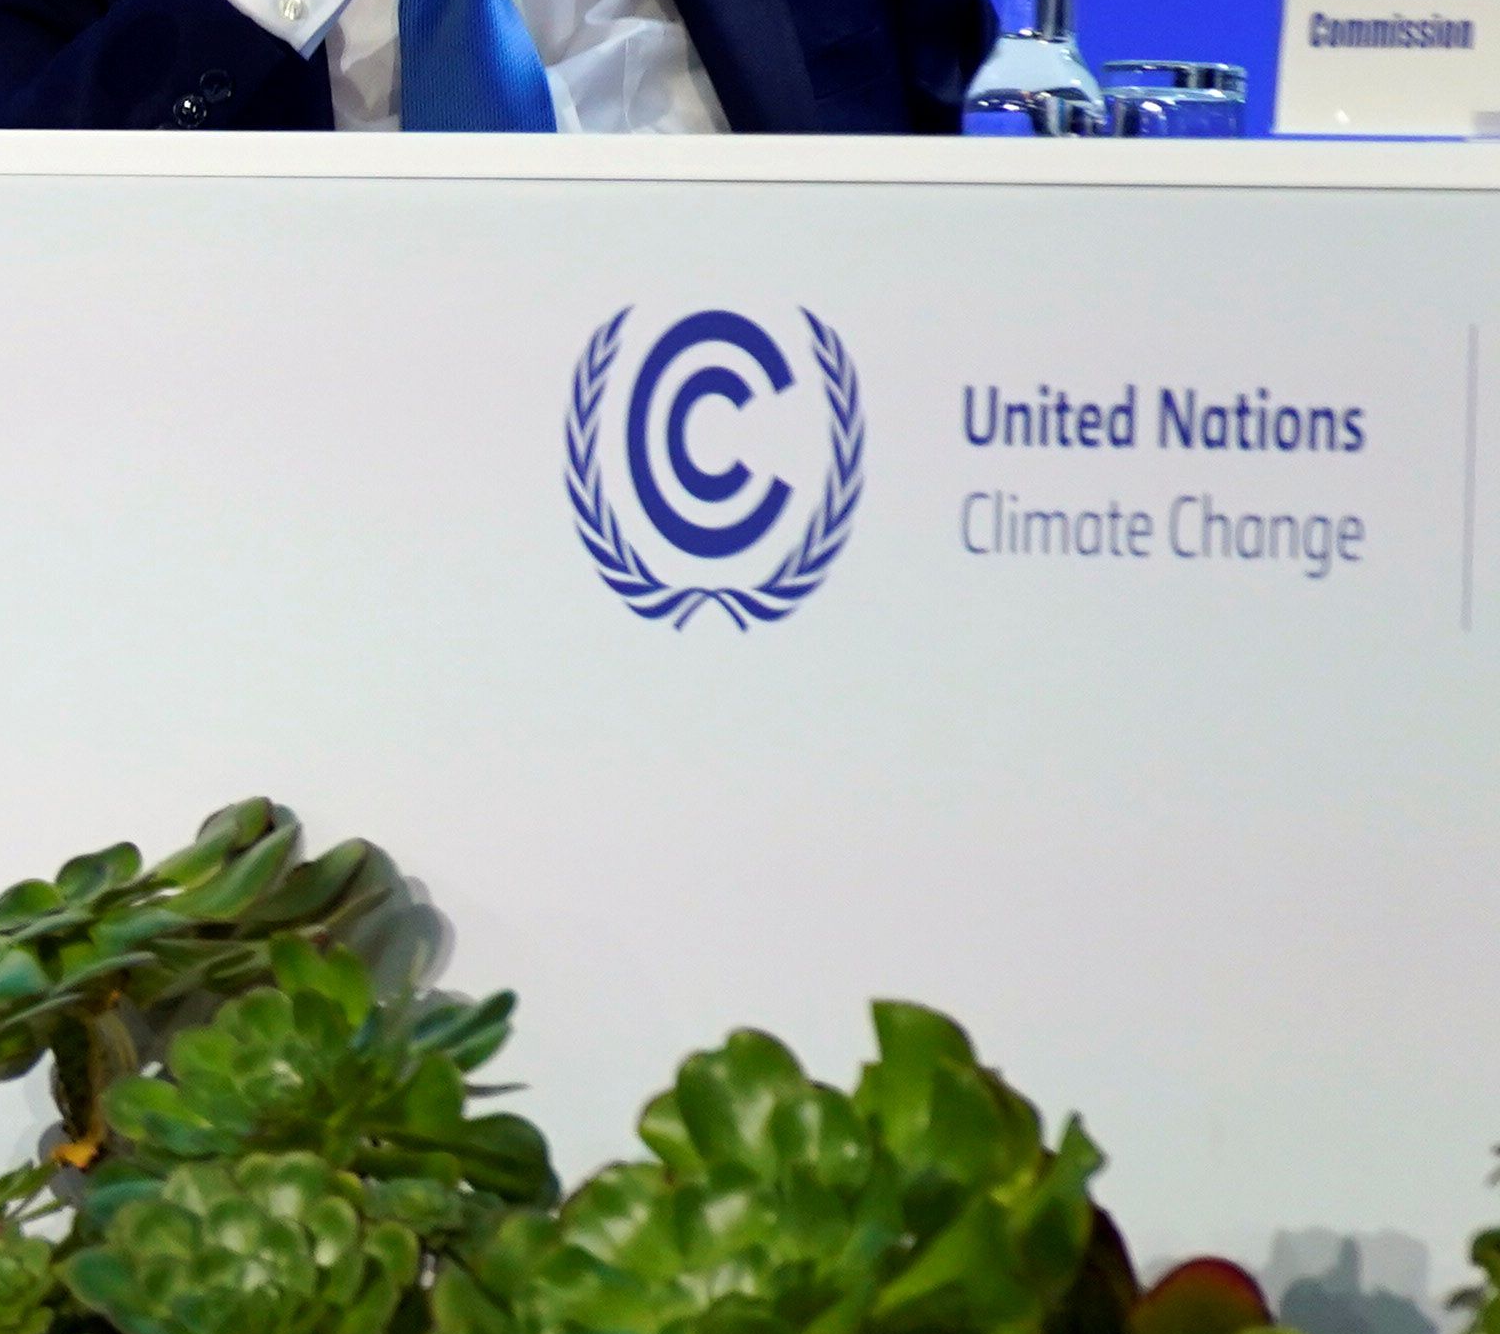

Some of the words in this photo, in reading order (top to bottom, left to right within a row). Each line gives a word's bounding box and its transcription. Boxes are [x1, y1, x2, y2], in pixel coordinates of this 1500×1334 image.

[964, 384, 1136, 449] United
[1159, 388, 1365, 453] Nations
[961, 490, 1154, 559] Climate
[1168, 493, 1366, 581] Change
